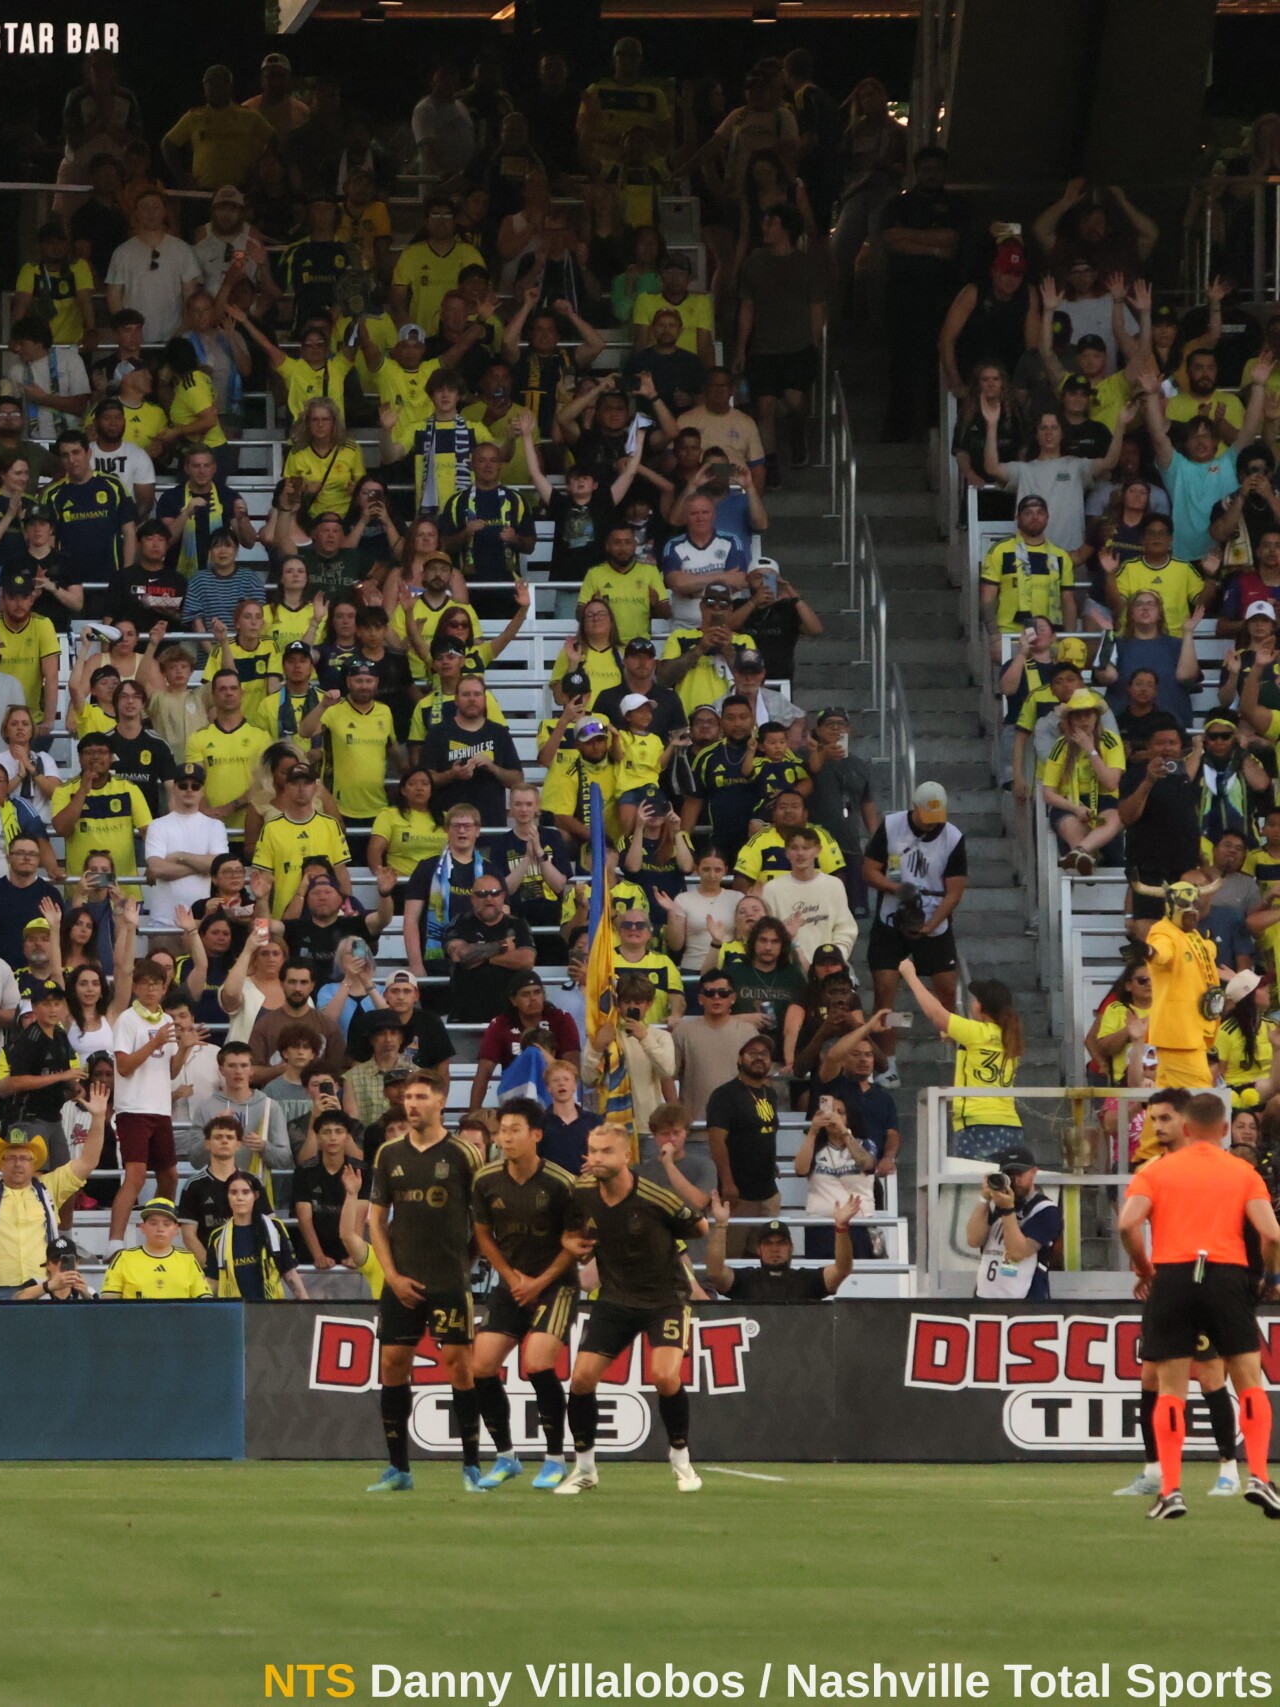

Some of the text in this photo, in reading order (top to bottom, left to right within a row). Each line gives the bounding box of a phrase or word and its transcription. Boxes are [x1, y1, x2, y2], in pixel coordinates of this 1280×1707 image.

[67, 22, 119, 53] BAR
[94, 456, 128, 473] JUST
[70, 510, 109, 520] RENASANT
[448, 740, 494, 762] NASHVILLE SC
[86, 824, 124, 833] RENASANT
[740, 986, 791, 1000] GUINNESS
[974, 1048, 1017, 1088] 30
[986, 1259, 999, 1282] 6
[432, 1308, 466, 1334] 24
[663, 1319, 680, 1340] 5
